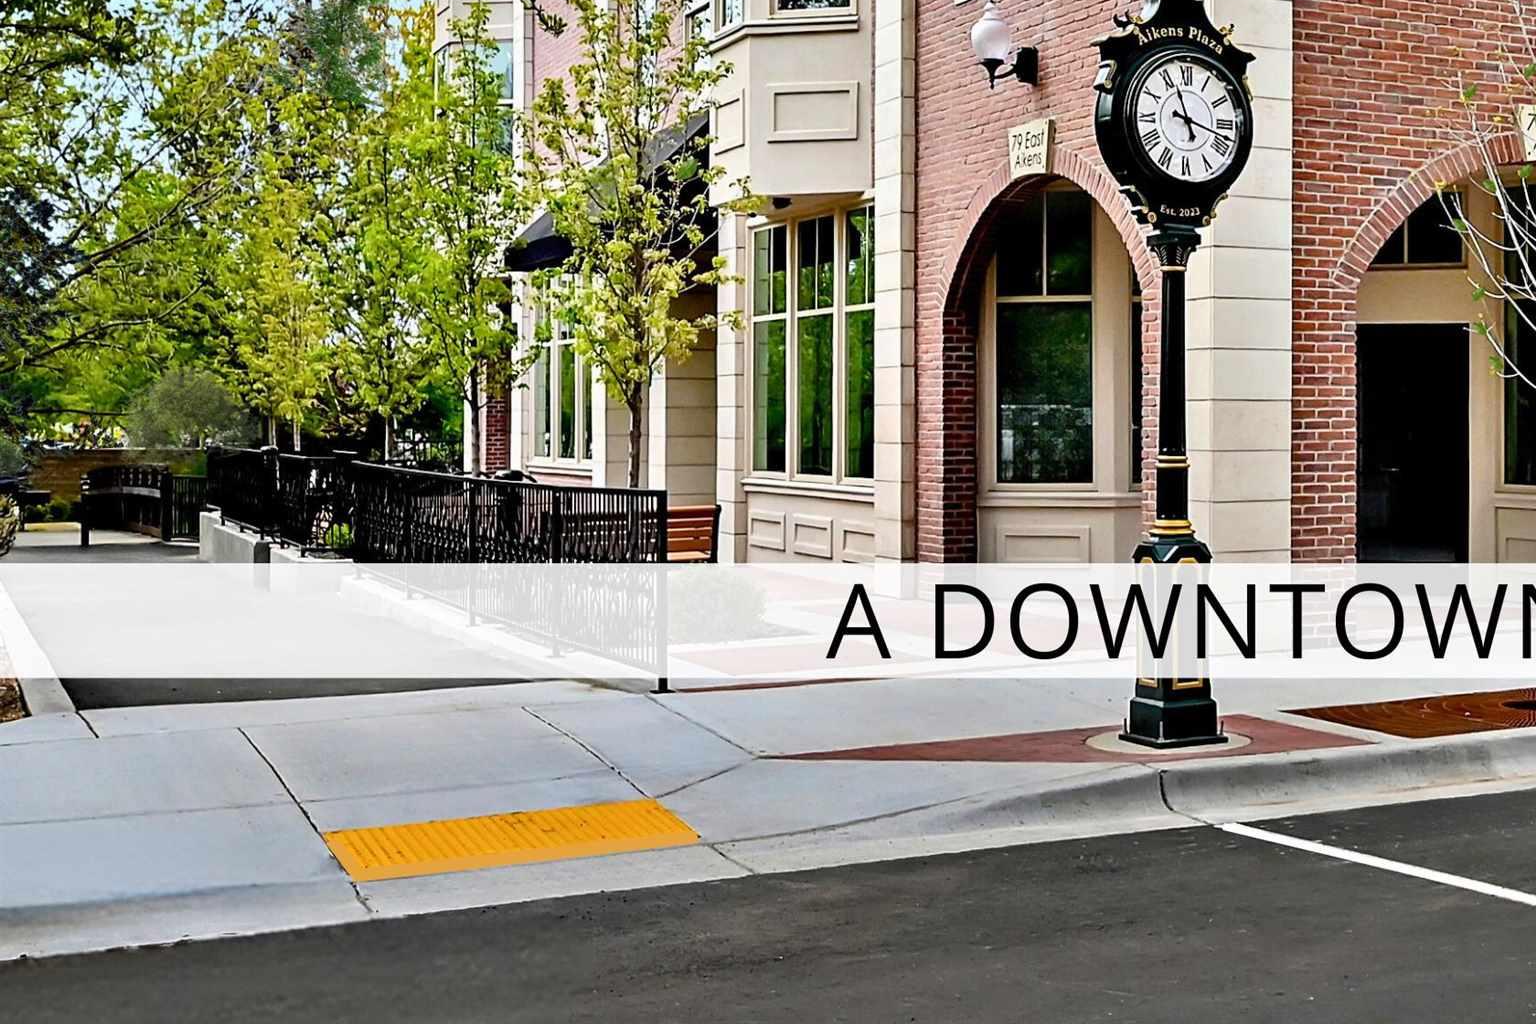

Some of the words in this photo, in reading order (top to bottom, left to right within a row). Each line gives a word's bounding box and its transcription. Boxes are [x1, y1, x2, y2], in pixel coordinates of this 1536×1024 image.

[1138, 26, 1184, 46] Aikens
[1188, 25, 1224, 55] Plaza
[1143, 86, 1162, 105] X
[1011, 133, 1023, 152] 79
[1025, 128, 1045, 149] East
[1179, 207, 1200, 217] 2023
